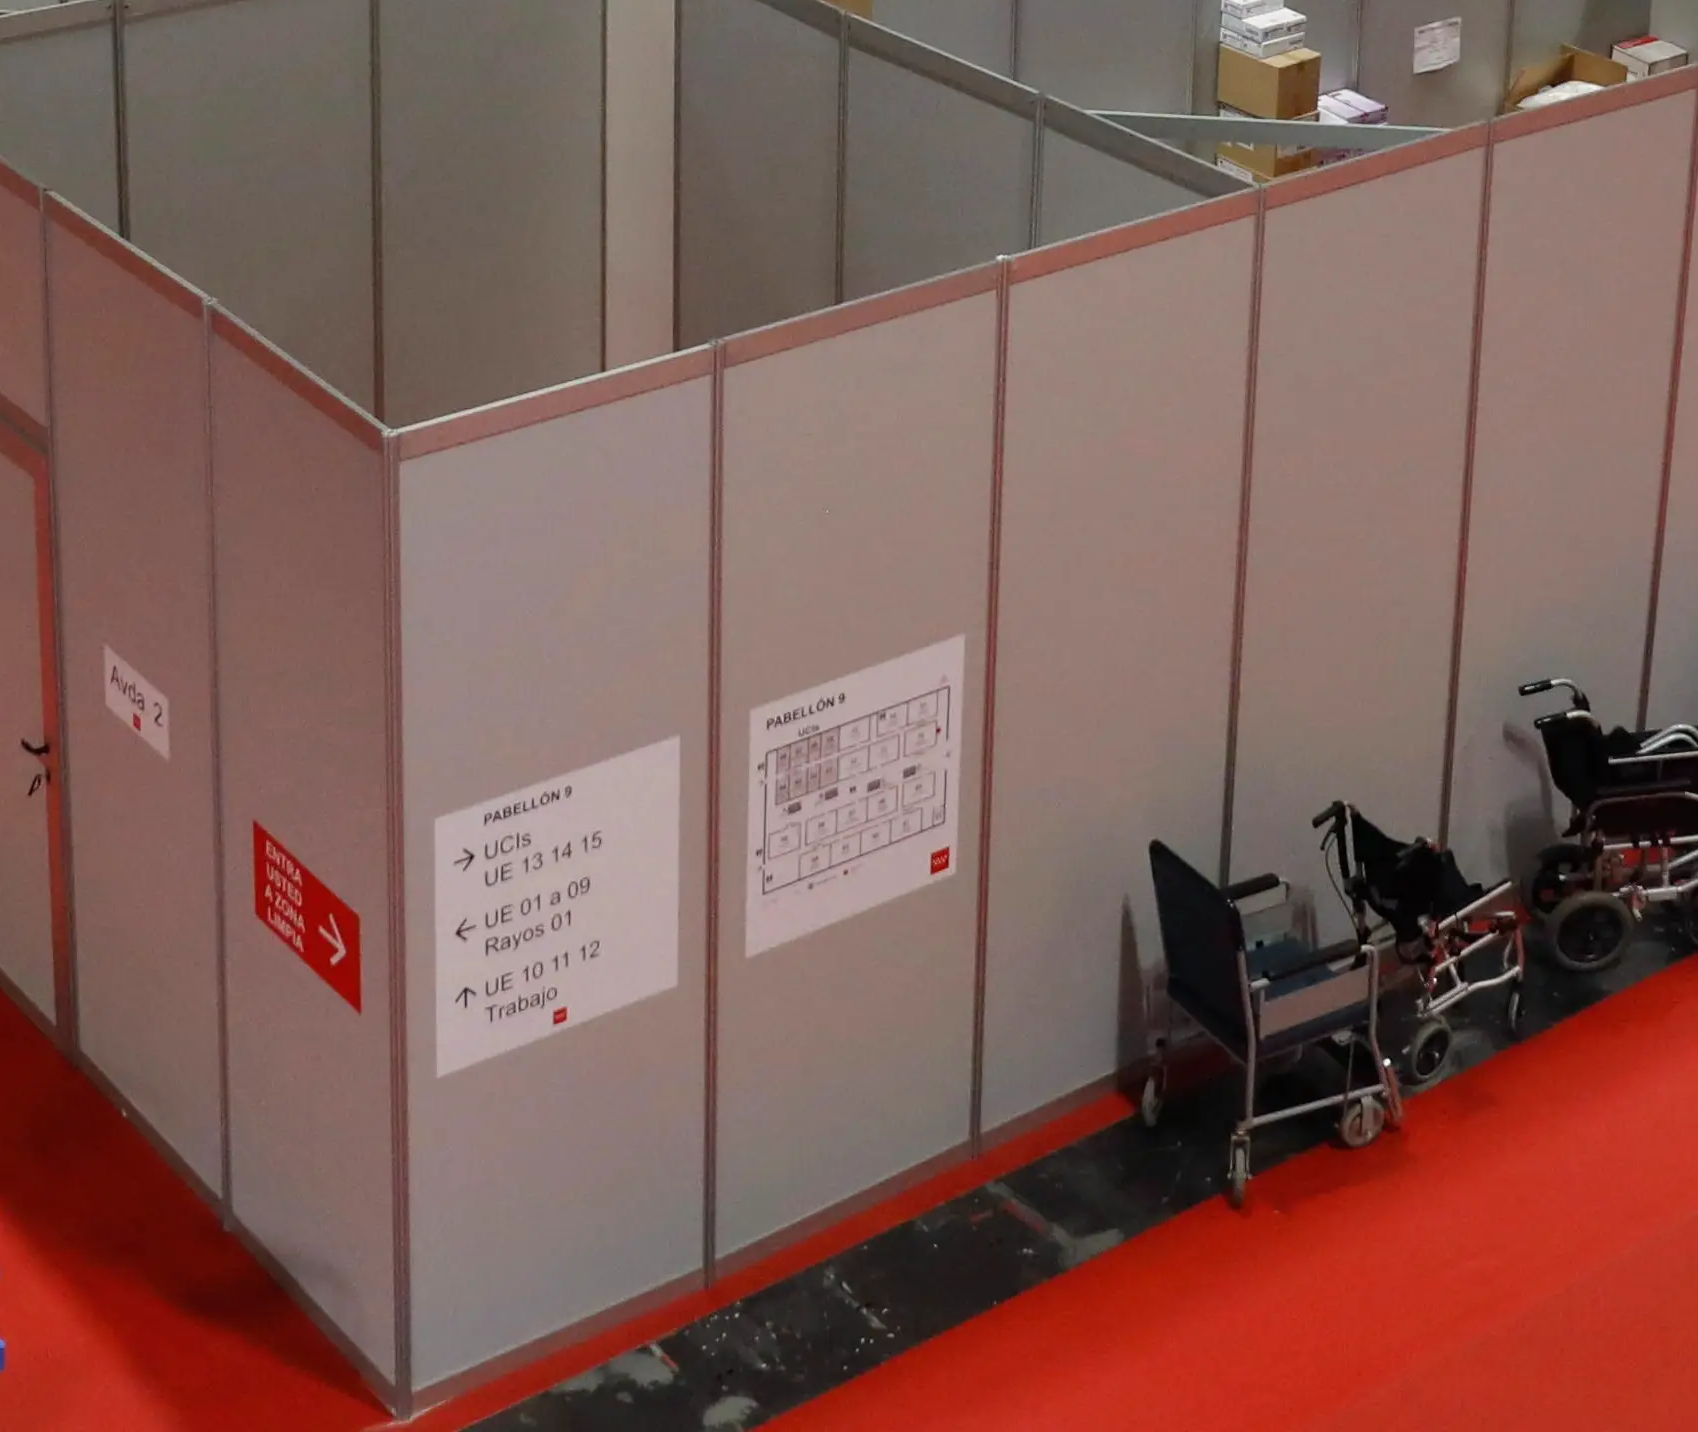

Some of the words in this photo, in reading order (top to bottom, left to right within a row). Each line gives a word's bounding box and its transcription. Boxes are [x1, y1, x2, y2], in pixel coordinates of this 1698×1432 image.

[110, 664, 145, 711] Avda
[153, 702, 163, 728] 2
[766, 696, 835, 730] PABELLÓN
[838, 692, 846, 704] 9
[484, 789, 561, 826] PABELLÓN
[564, 785, 573, 798] 9
[265, 840, 303, 886] ENTRA
[485, 832, 532, 860] UCIs
[485, 862, 513, 887] UE
[523, 852, 543, 874] 13
[552, 841, 572, 862] 14
[582, 830, 602, 853] 15
[266, 861, 302, 907] USTED
[485, 904, 513, 928] UE
[520, 894, 541, 916] 01
[549, 891, 561, 906] a
[567, 877, 590, 898] 09
[264, 885, 273, 903] A
[274, 891, 305, 933] ZONA
[267, 907, 304, 953] LIMPIA
[485, 924, 545, 956] Rayos
[551, 910, 572, 931] 01
[485, 972, 514, 997] UE
[523, 962, 543, 982] 10
[552, 951, 569, 972] 11
[580, 940, 600, 961] 12
[485, 987, 558, 1023] Trabajo
